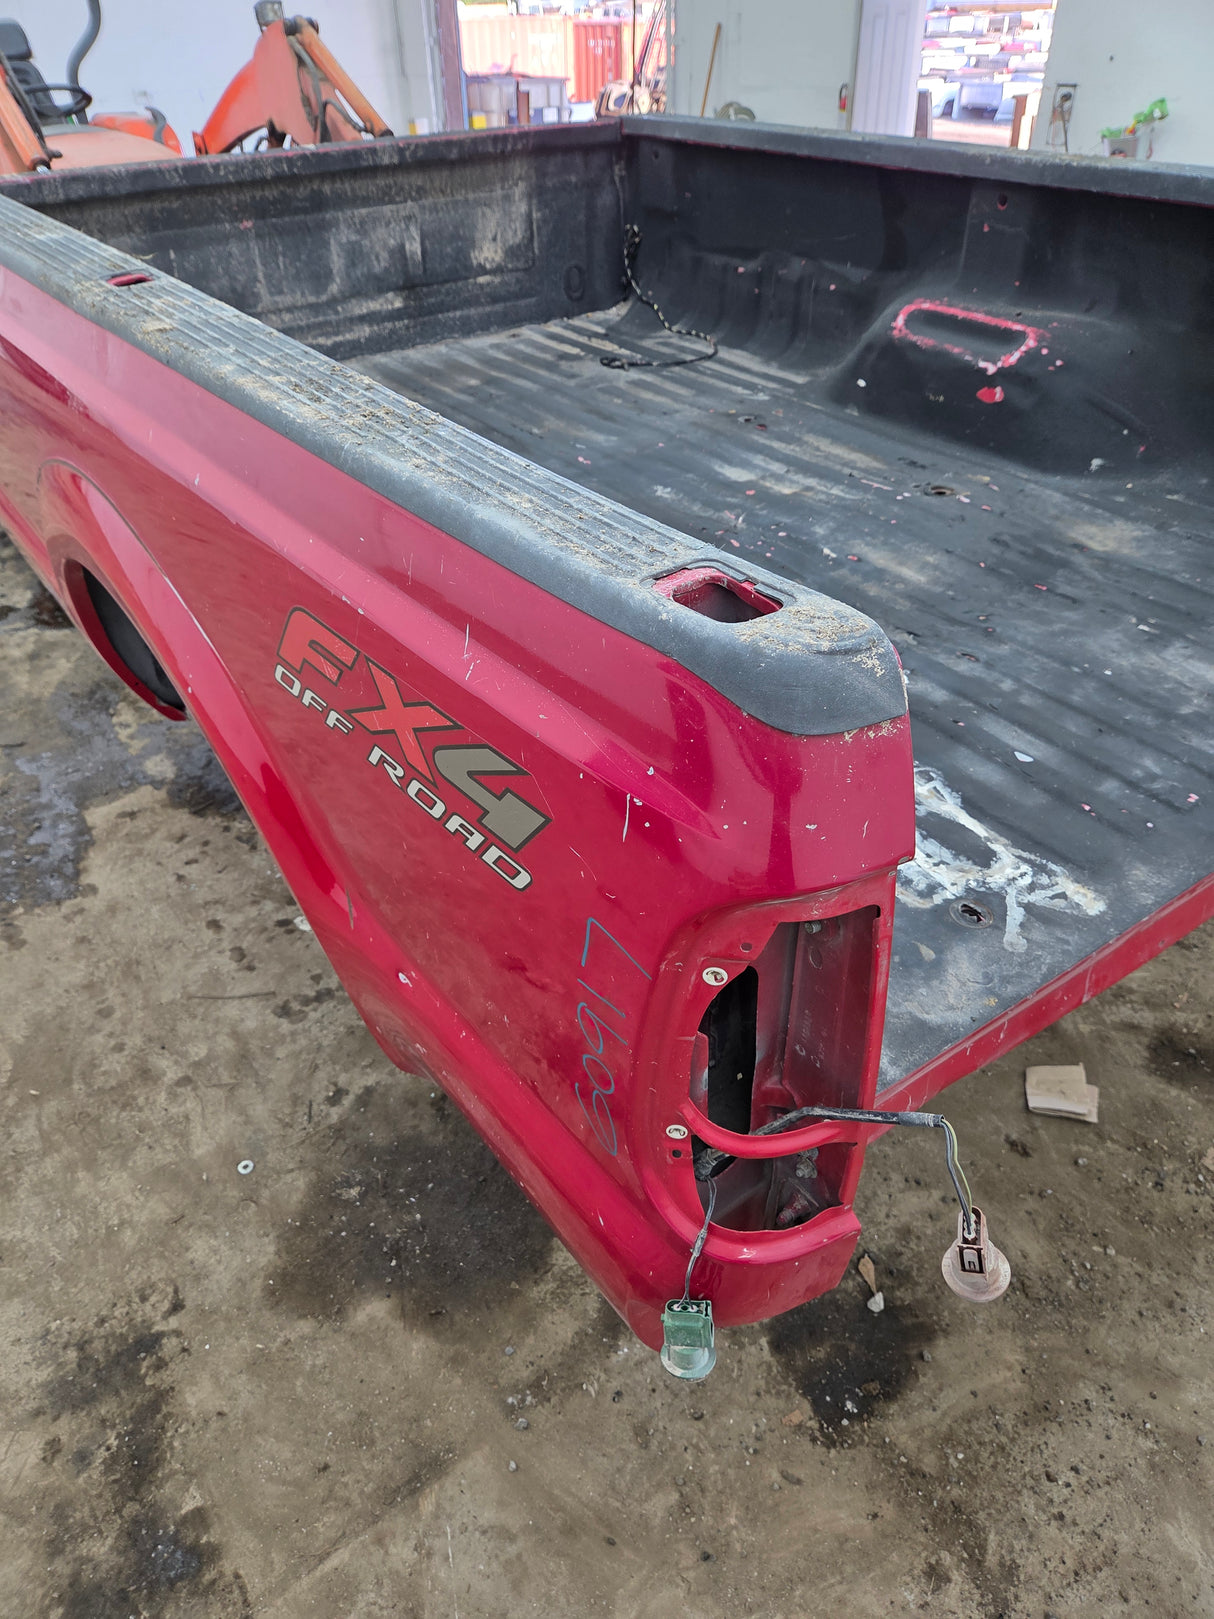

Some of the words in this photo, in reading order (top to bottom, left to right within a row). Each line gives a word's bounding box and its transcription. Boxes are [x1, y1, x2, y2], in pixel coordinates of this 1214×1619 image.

[274, 663, 354, 735] OFF
[367, 744, 533, 891] ROAD
[276, 605, 553, 853] FX4
[575, 917, 652, 1156] 60917
